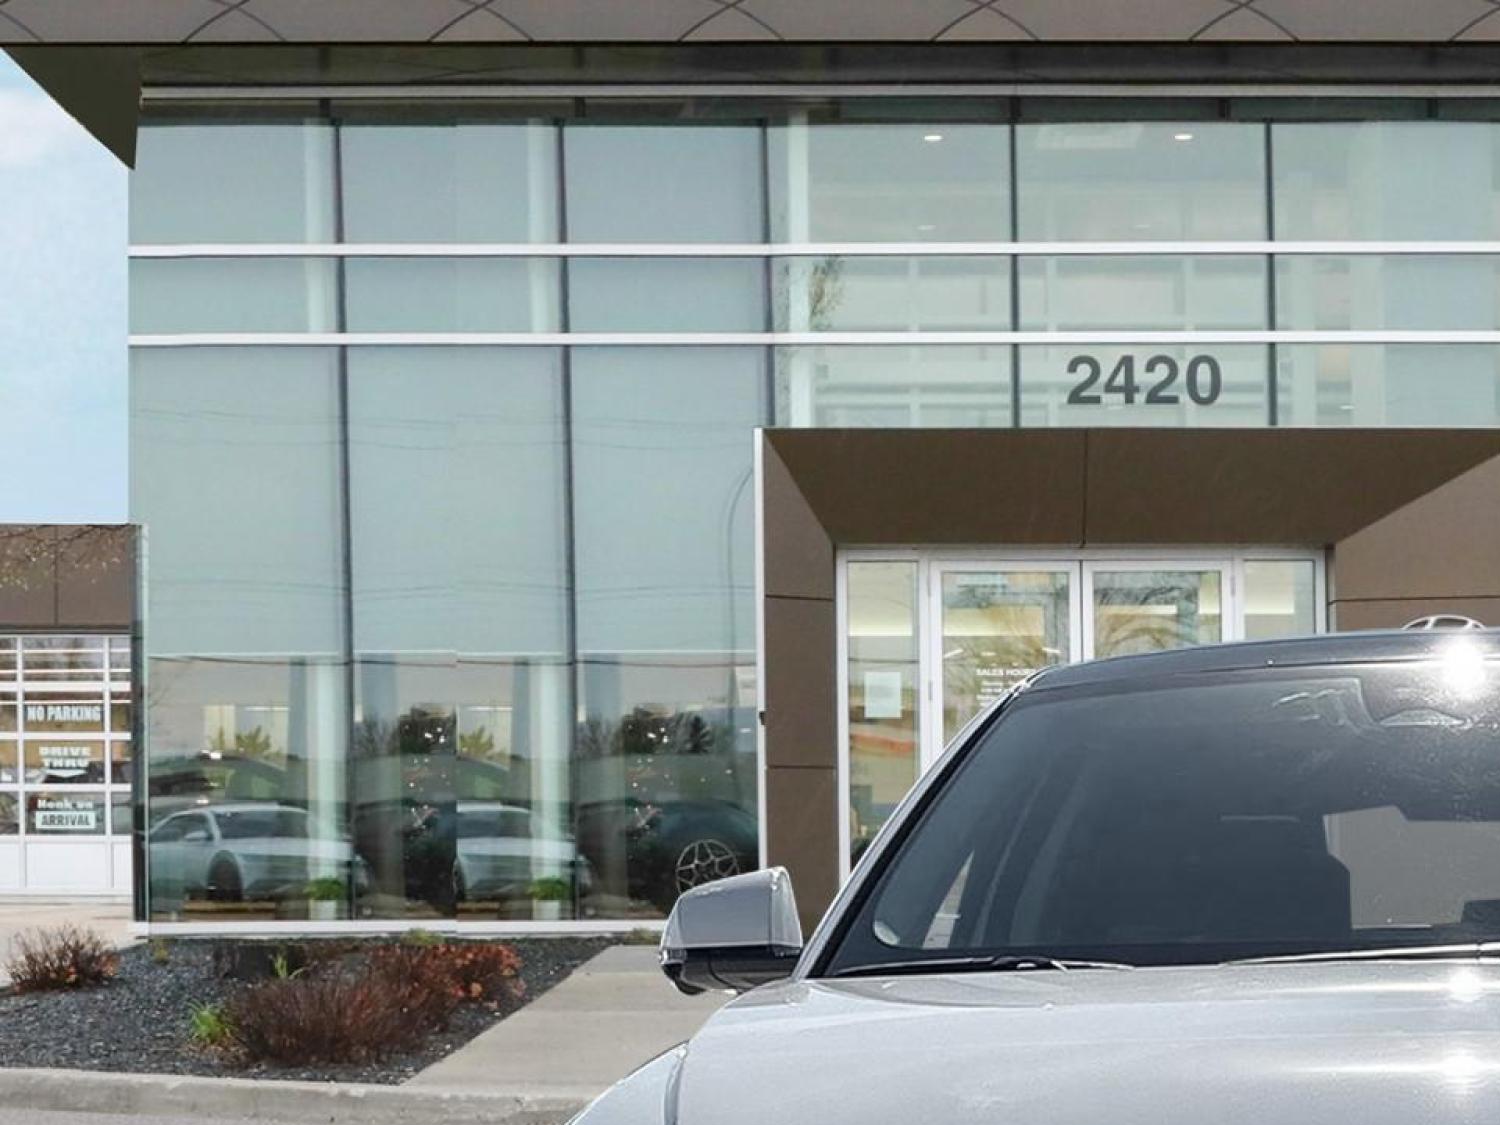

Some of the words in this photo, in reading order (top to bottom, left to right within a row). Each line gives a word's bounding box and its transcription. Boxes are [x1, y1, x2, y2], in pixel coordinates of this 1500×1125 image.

[1066, 354, 1222, 406] 2420
[27, 705, 45, 722] NO
[47, 705, 101, 722] PARKING
[43, 758, 89, 768] THRU
[41, 813, 91, 826] ARRIVAL
